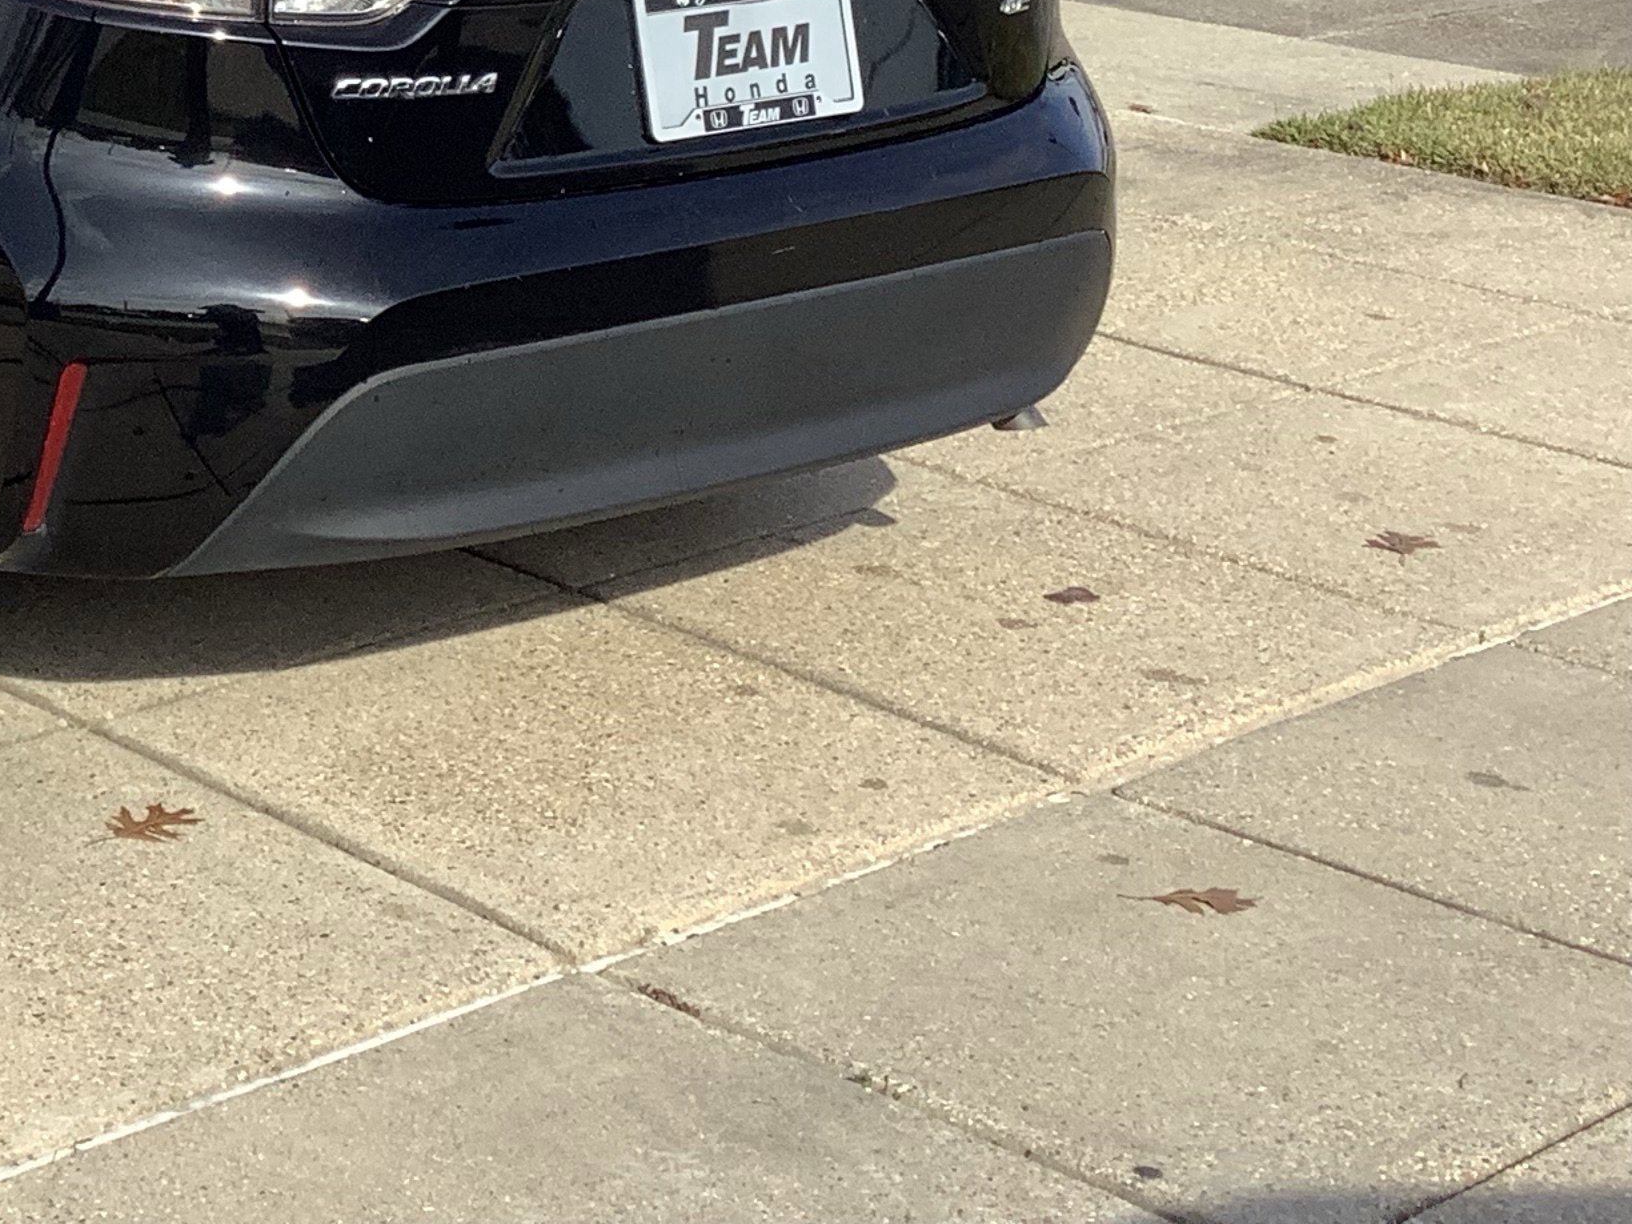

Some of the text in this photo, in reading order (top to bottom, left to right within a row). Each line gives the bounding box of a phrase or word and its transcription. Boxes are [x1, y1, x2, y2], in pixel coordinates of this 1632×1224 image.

[683, 9, 810, 81] TEAM
[331, 72, 499, 100] COROLLA
[693, 72, 817, 108] Honda
[739, 102, 781, 126] TEAM
